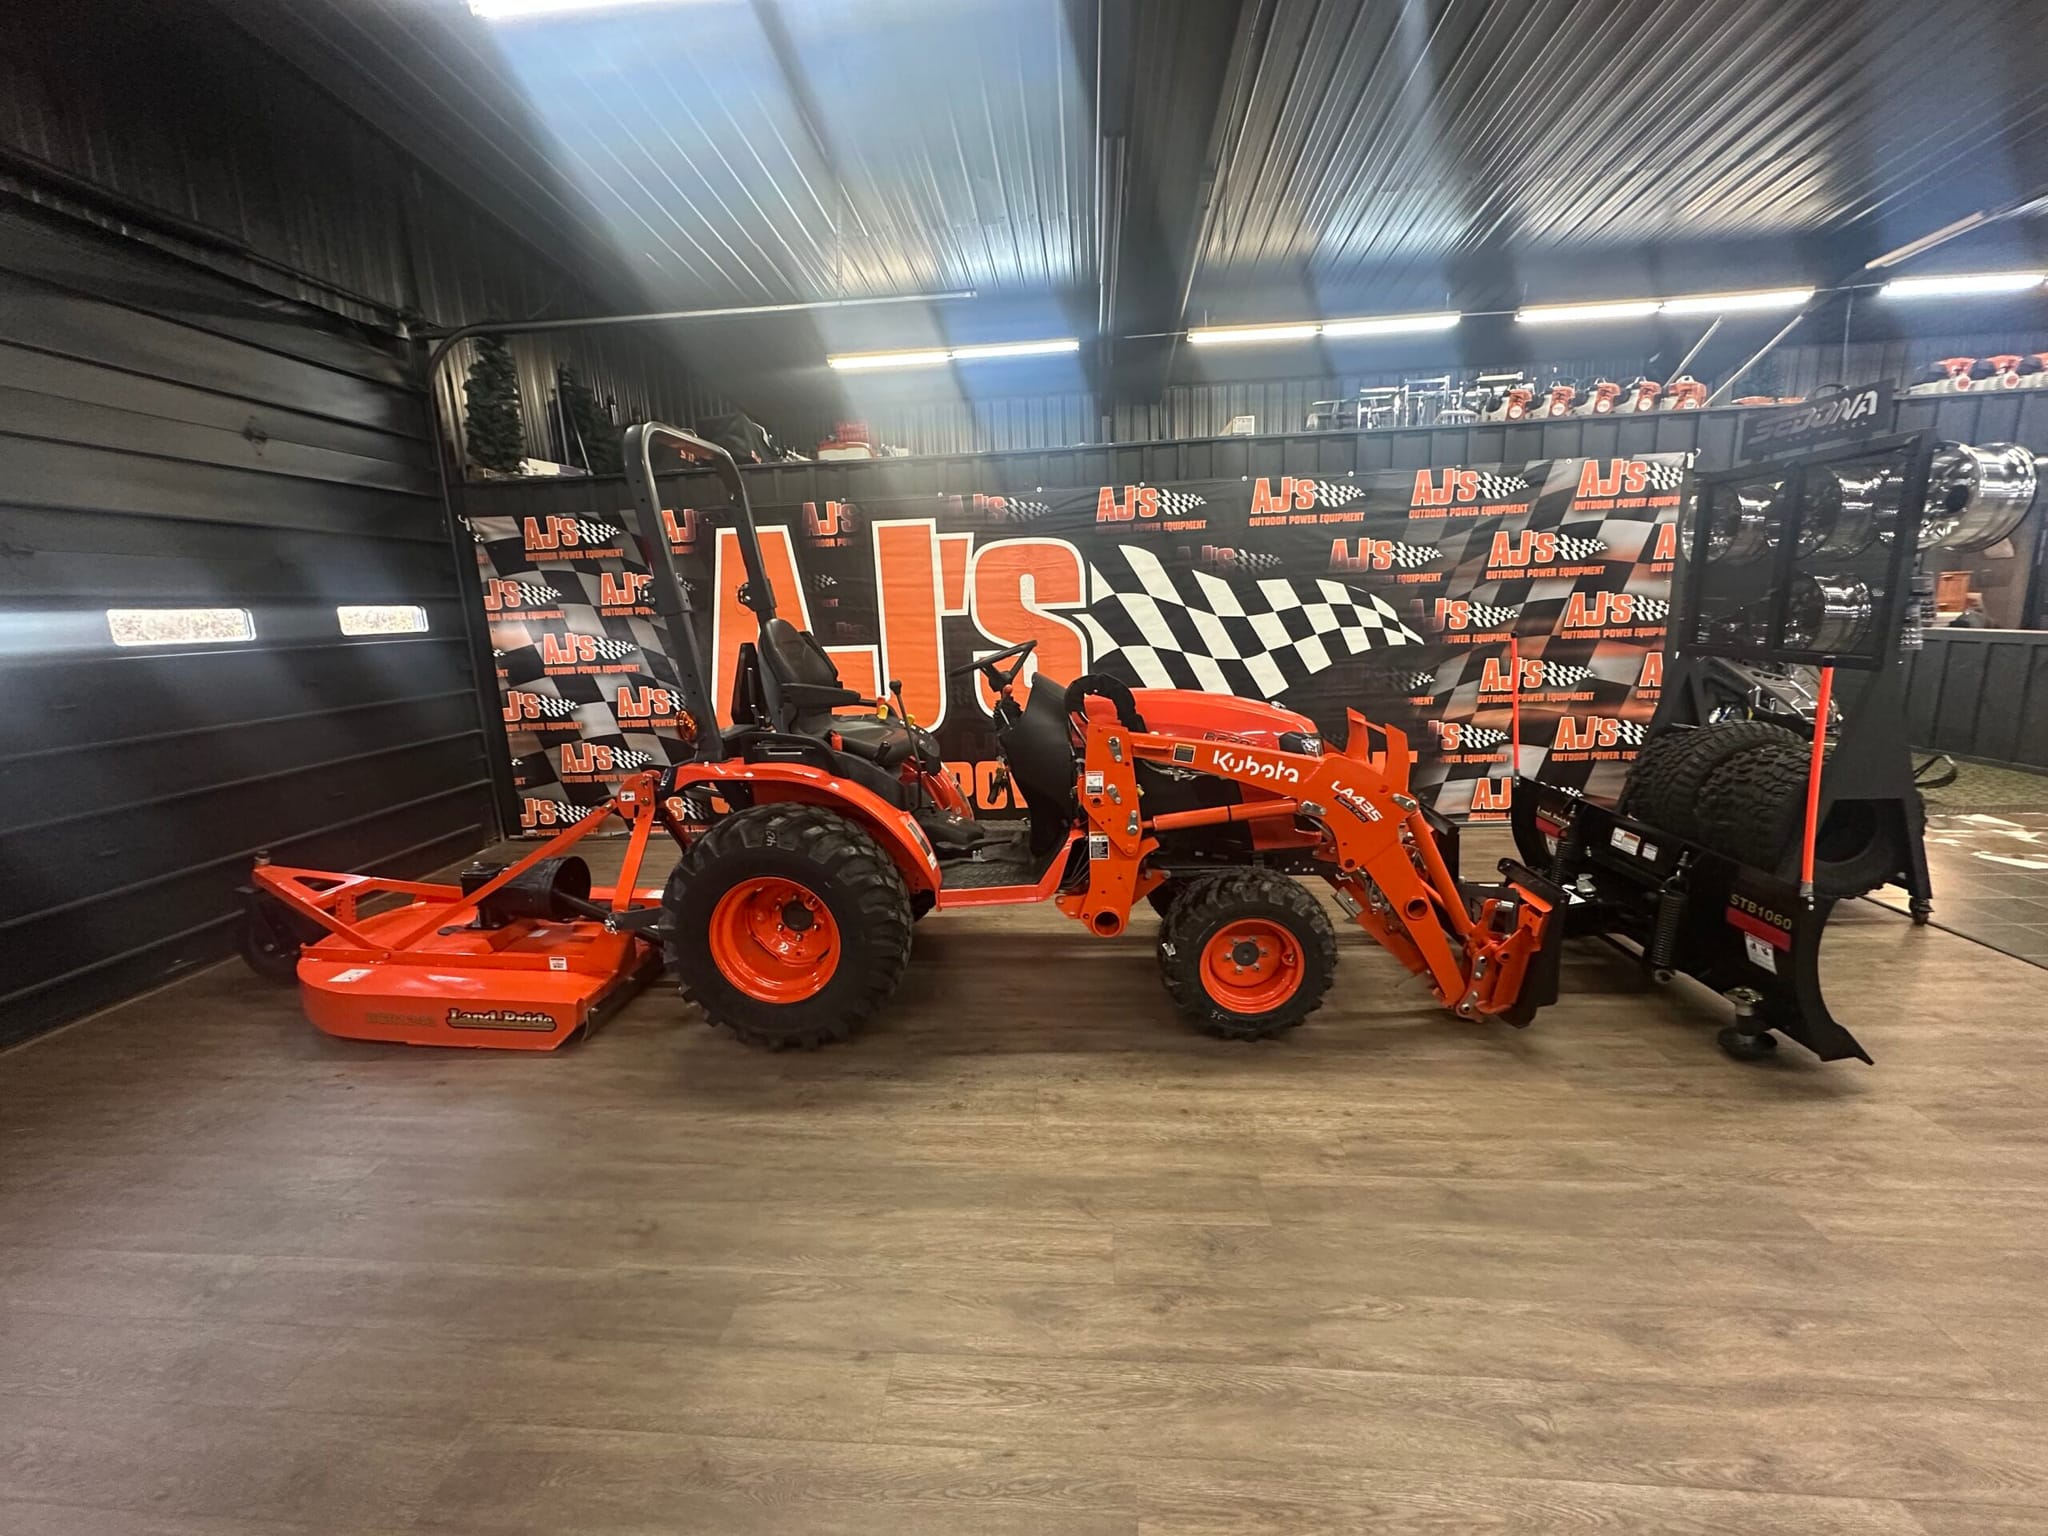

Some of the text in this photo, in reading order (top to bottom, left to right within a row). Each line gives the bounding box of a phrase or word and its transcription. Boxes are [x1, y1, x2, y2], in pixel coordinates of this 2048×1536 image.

[1747, 390, 1878, 444] SEDONA
[1411, 468, 1478, 506] AJ'S
[1576, 458, 1647, 497] AJ'S
[1096, 485, 1158, 522] AJ'S
[1250, 476, 1315, 514] AJ'S
[1408, 503, 1529, 519] OUTDOOR POWER EQUIPMENT
[1574, 496, 1680, 511] OUTDOOR POWER EQUIPM
[524, 516, 578, 550] AJ'S
[661, 509, 697, 543] AJ
[802, 501, 857, 536] AJ'S
[1163, 519, 1206, 532] EQUIPMENT
[1249, 511, 1365, 526] OUTDOOR POWER EQUIPMENT
[559, 550, 583, 560] POWER
[585, 548, 624, 559] EQUIPMENT
[1329, 538, 1392, 571] AJ'S
[1488, 530, 1556, 567] AJ'S
[1397, 572, 1442, 584] EQUIPMENT
[1486, 565, 1605, 580] OUTDOOR POWER EQUIPMENT
[483, 578, 521, 611] J'S
[1564, 591, 1633, 627] AJ'S
[601, 607, 634, 616] OUTDOOR
[711, 518, 1088, 735] AJ'S
[543, 632, 596, 664] AJ'S
[1561, 630, 1600, 639] OUTDOOR
[1603, 628, 1632, 638] POWER
[544, 664, 640, 676] OUTDOOR POWER EQUIPMENT
[1479, 657, 1543, 692] AJ'S
[502, 691, 540, 721] J'S
[617, 686, 670, 717] AJ'S
[1547, 692, 1594, 702] EQUIPMENT
[1554, 716, 1618, 750] AJ'S
[561, 743, 613, 773] AJ'S
[1213, 750, 1299, 783] Kubota
[1464, 754, 1507, 763] EQUIPMENT
[1552, 752, 1588, 761] OUTDOOR
[1591, 751, 1619, 760] POWER
[1331, 780, 1383, 822] LA435
[1471, 777, 1511, 809] AJ
[520, 798, 556, 827] J'S
[1730, 894, 1792, 930] STB1060
[450, 1009, 496, 1024] Land
[503, 1011, 553, 1027] Pride
